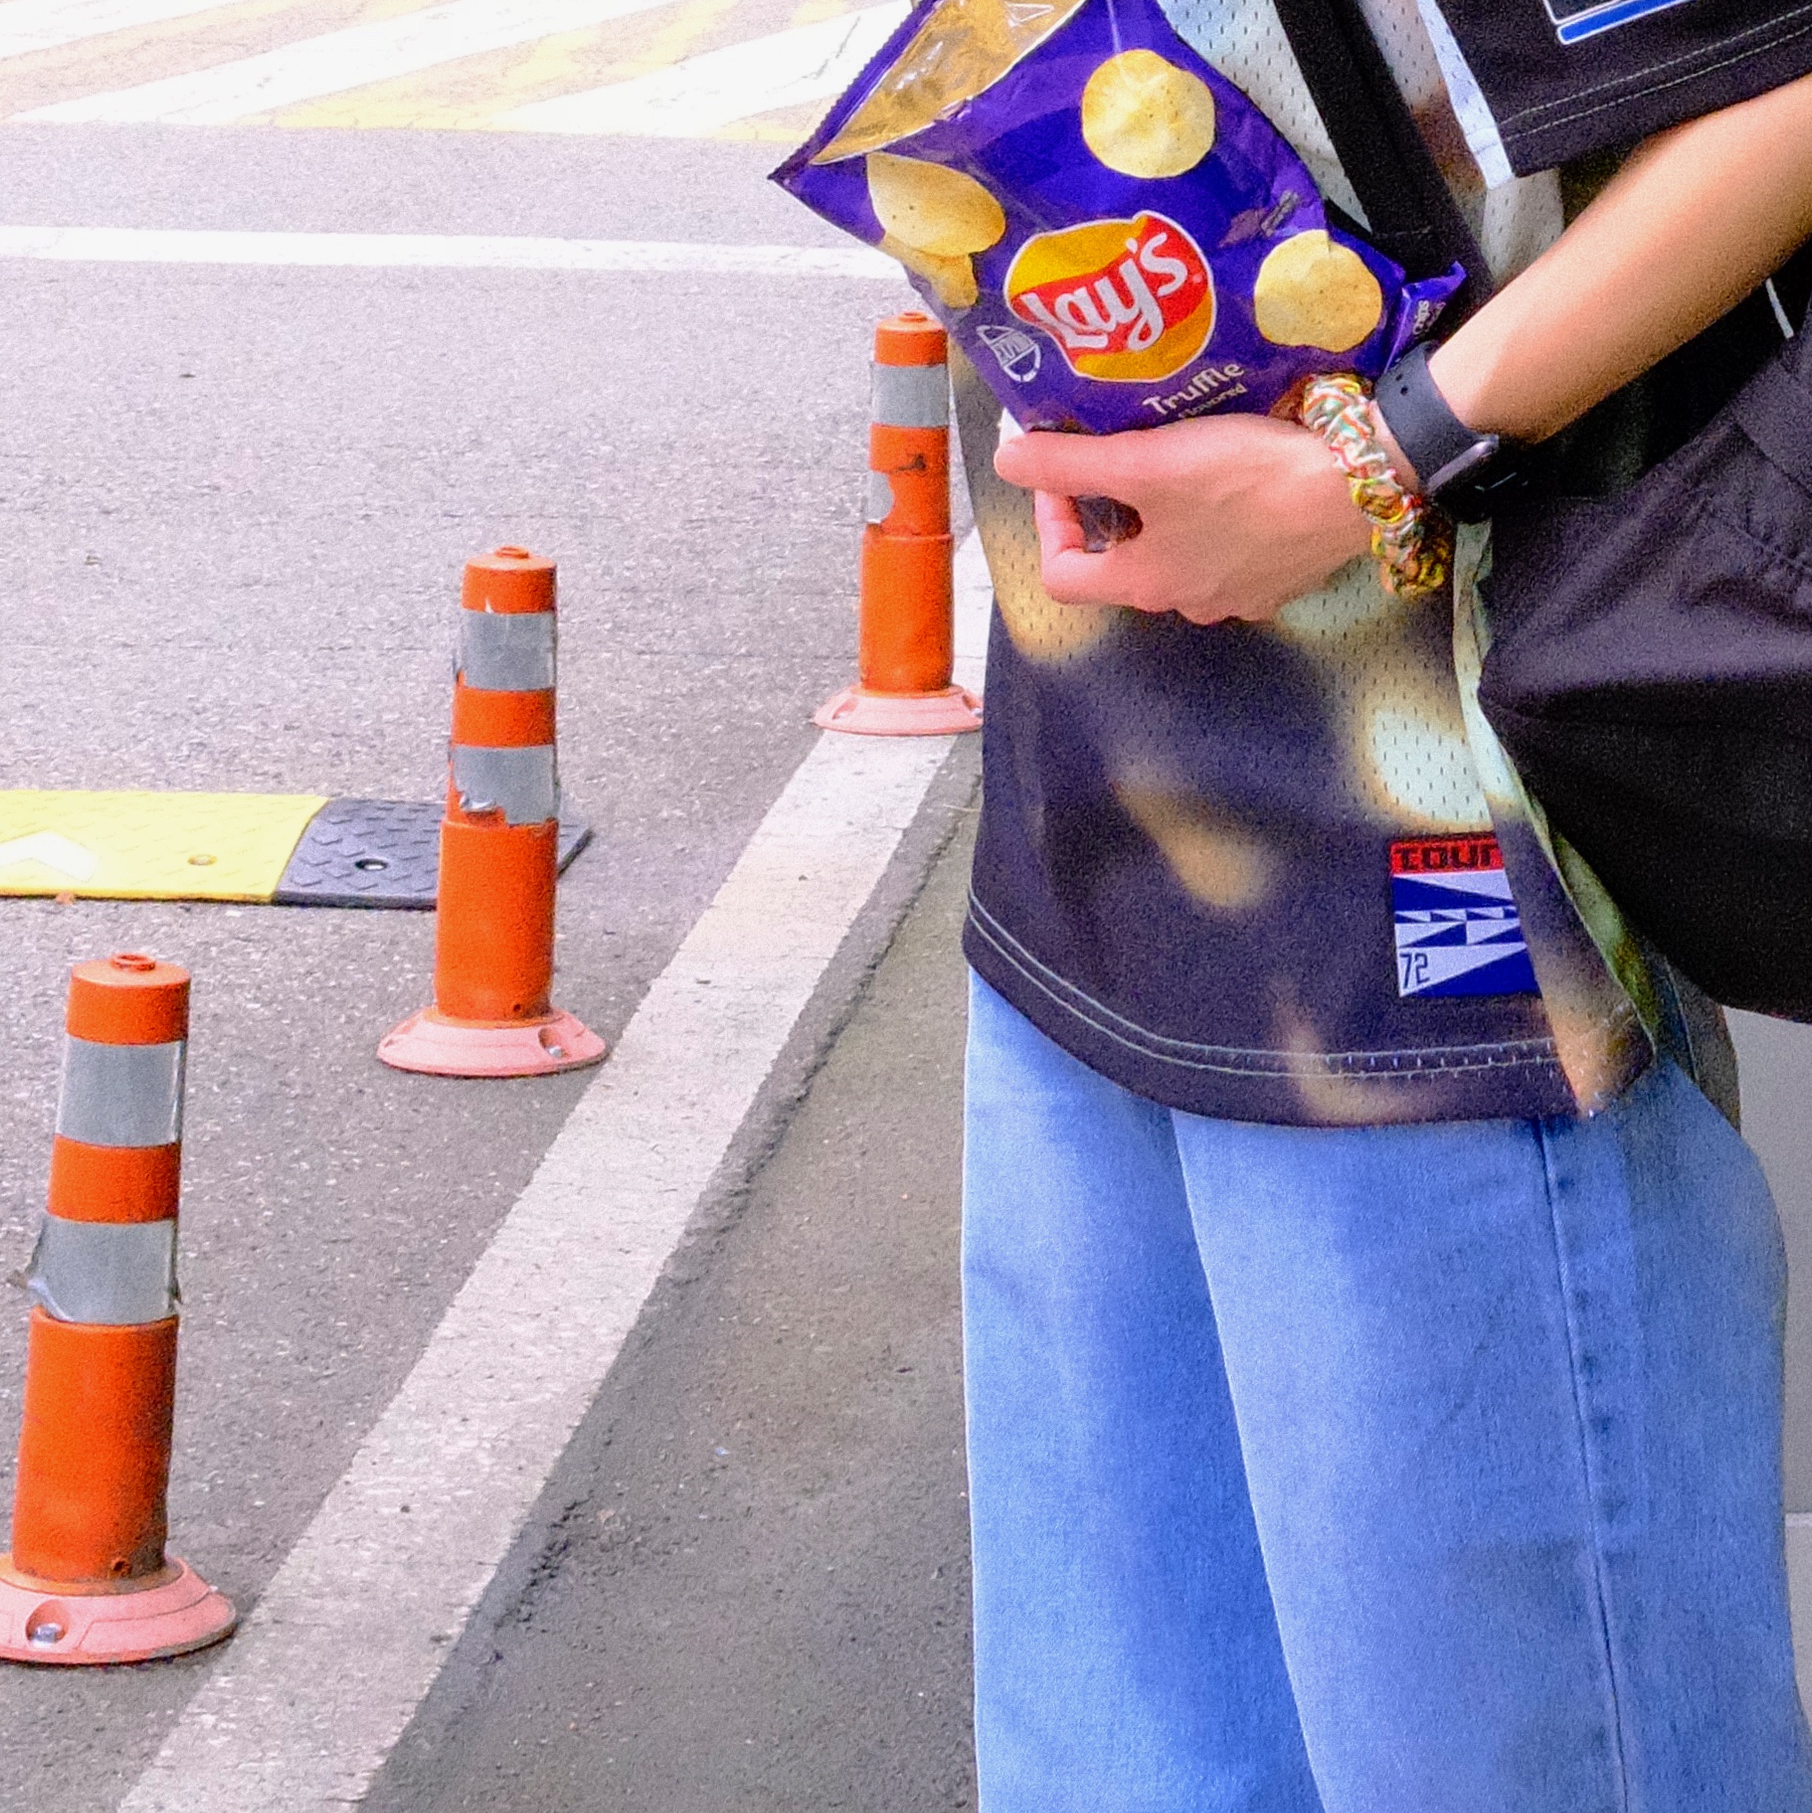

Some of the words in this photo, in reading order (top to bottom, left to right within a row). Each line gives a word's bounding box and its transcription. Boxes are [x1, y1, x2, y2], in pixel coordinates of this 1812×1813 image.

[1019, 232, 1189, 352] Lay's
[1142, 363, 1245, 416] Truffle
[1399, 953, 1430, 989] 72
